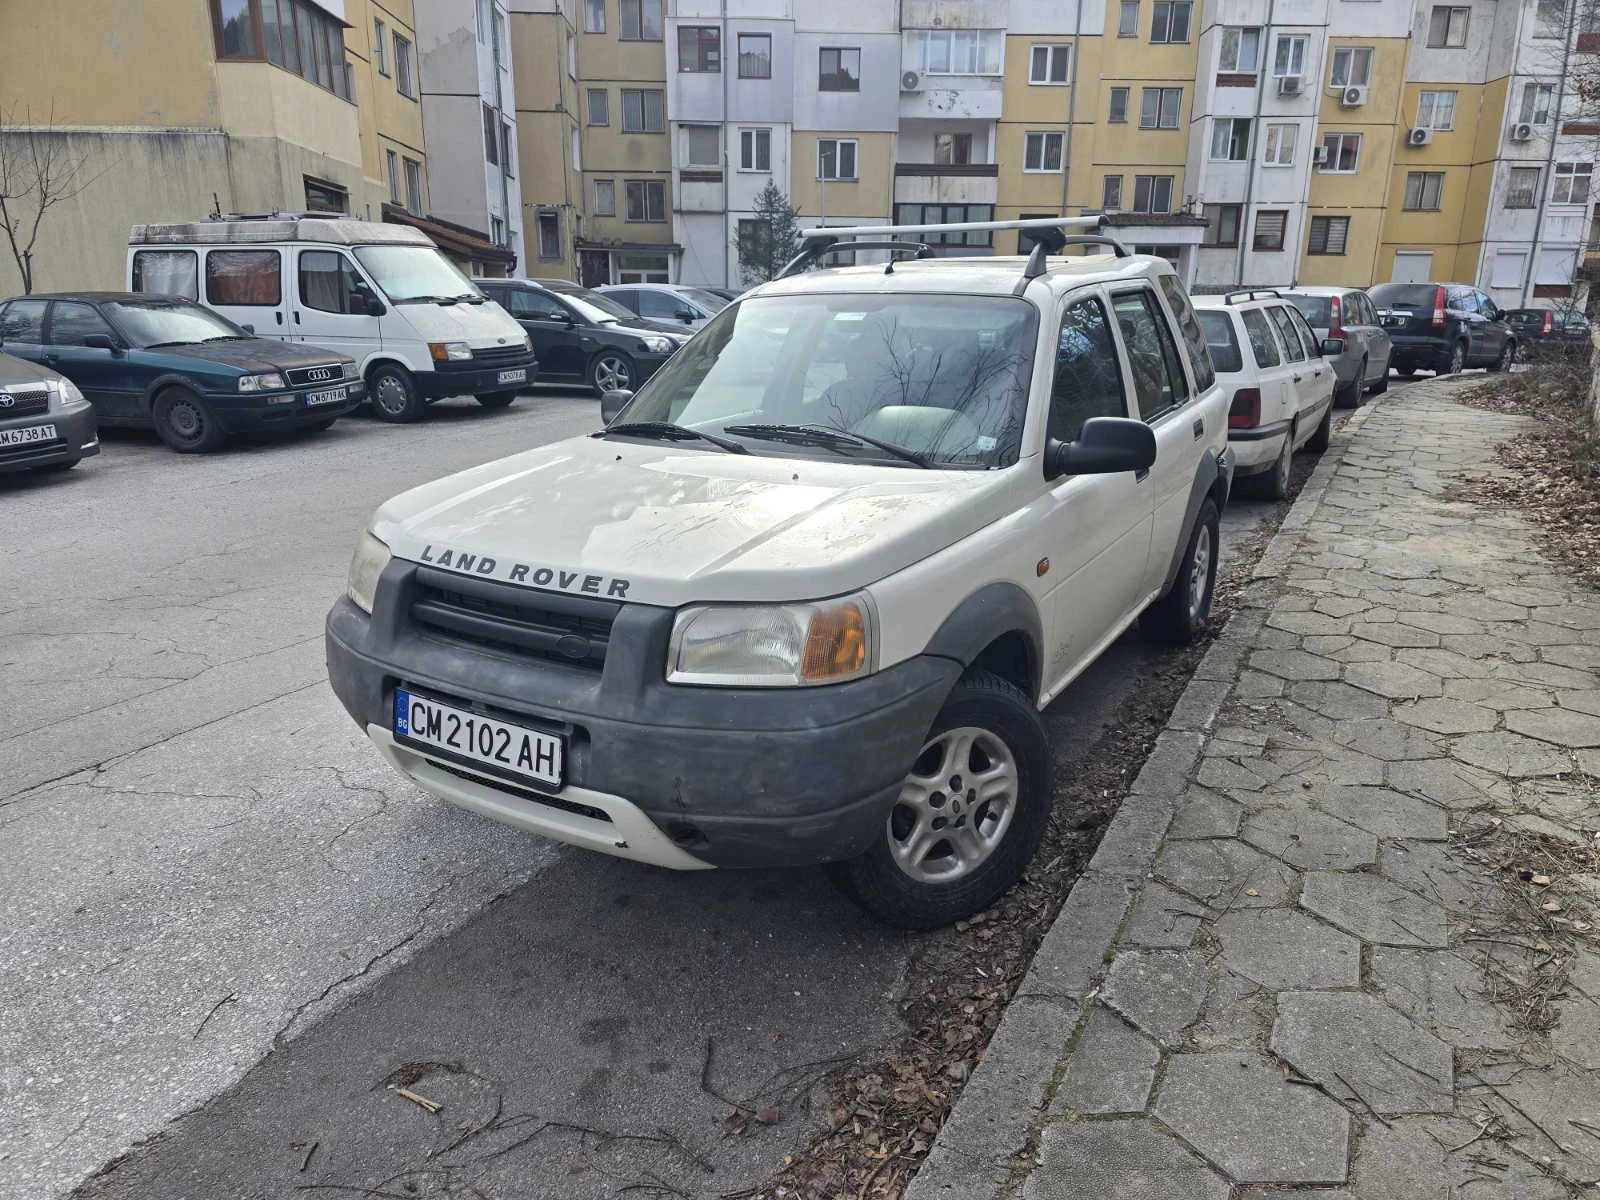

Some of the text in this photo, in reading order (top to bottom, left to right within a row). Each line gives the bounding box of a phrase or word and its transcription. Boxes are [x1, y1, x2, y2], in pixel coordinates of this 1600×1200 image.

[420, 545, 631, 598] LAND ROVER
[397, 717, 408, 729] BG
